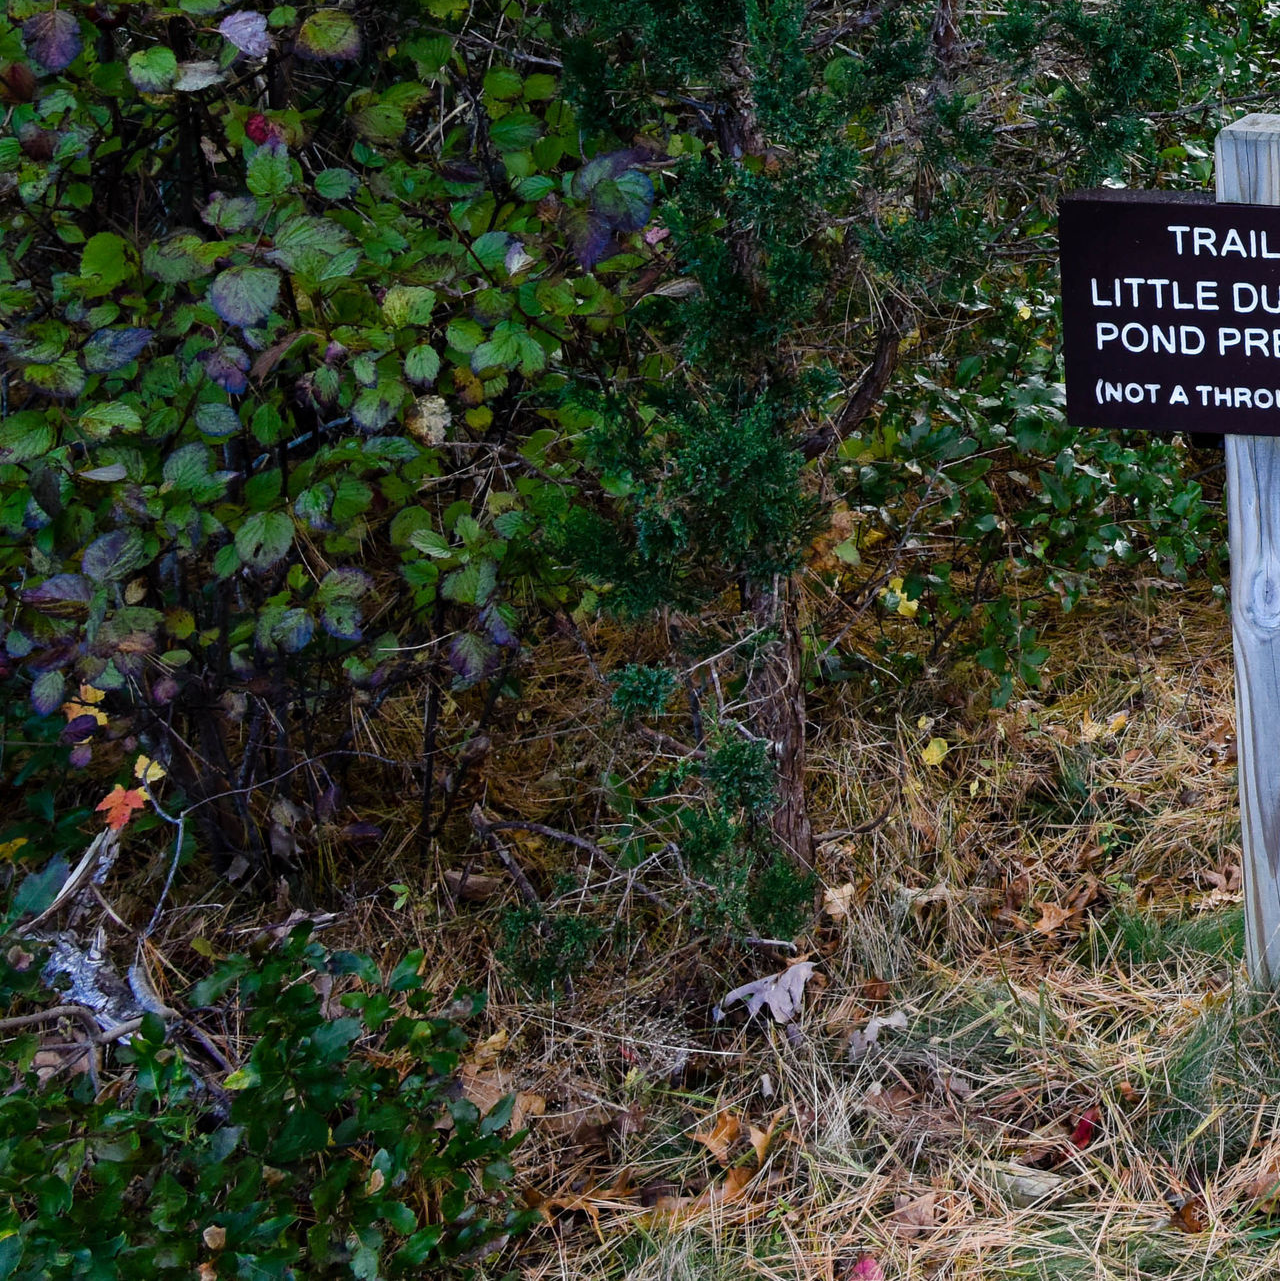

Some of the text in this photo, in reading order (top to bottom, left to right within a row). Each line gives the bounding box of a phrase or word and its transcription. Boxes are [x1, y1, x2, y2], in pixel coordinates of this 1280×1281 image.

[1092, 278, 1219, 310] LITTLE
[1097, 323, 1205, 354] POND
[1096, 379, 1160, 404] (NOT
[1169, 385, 1189, 405] A
